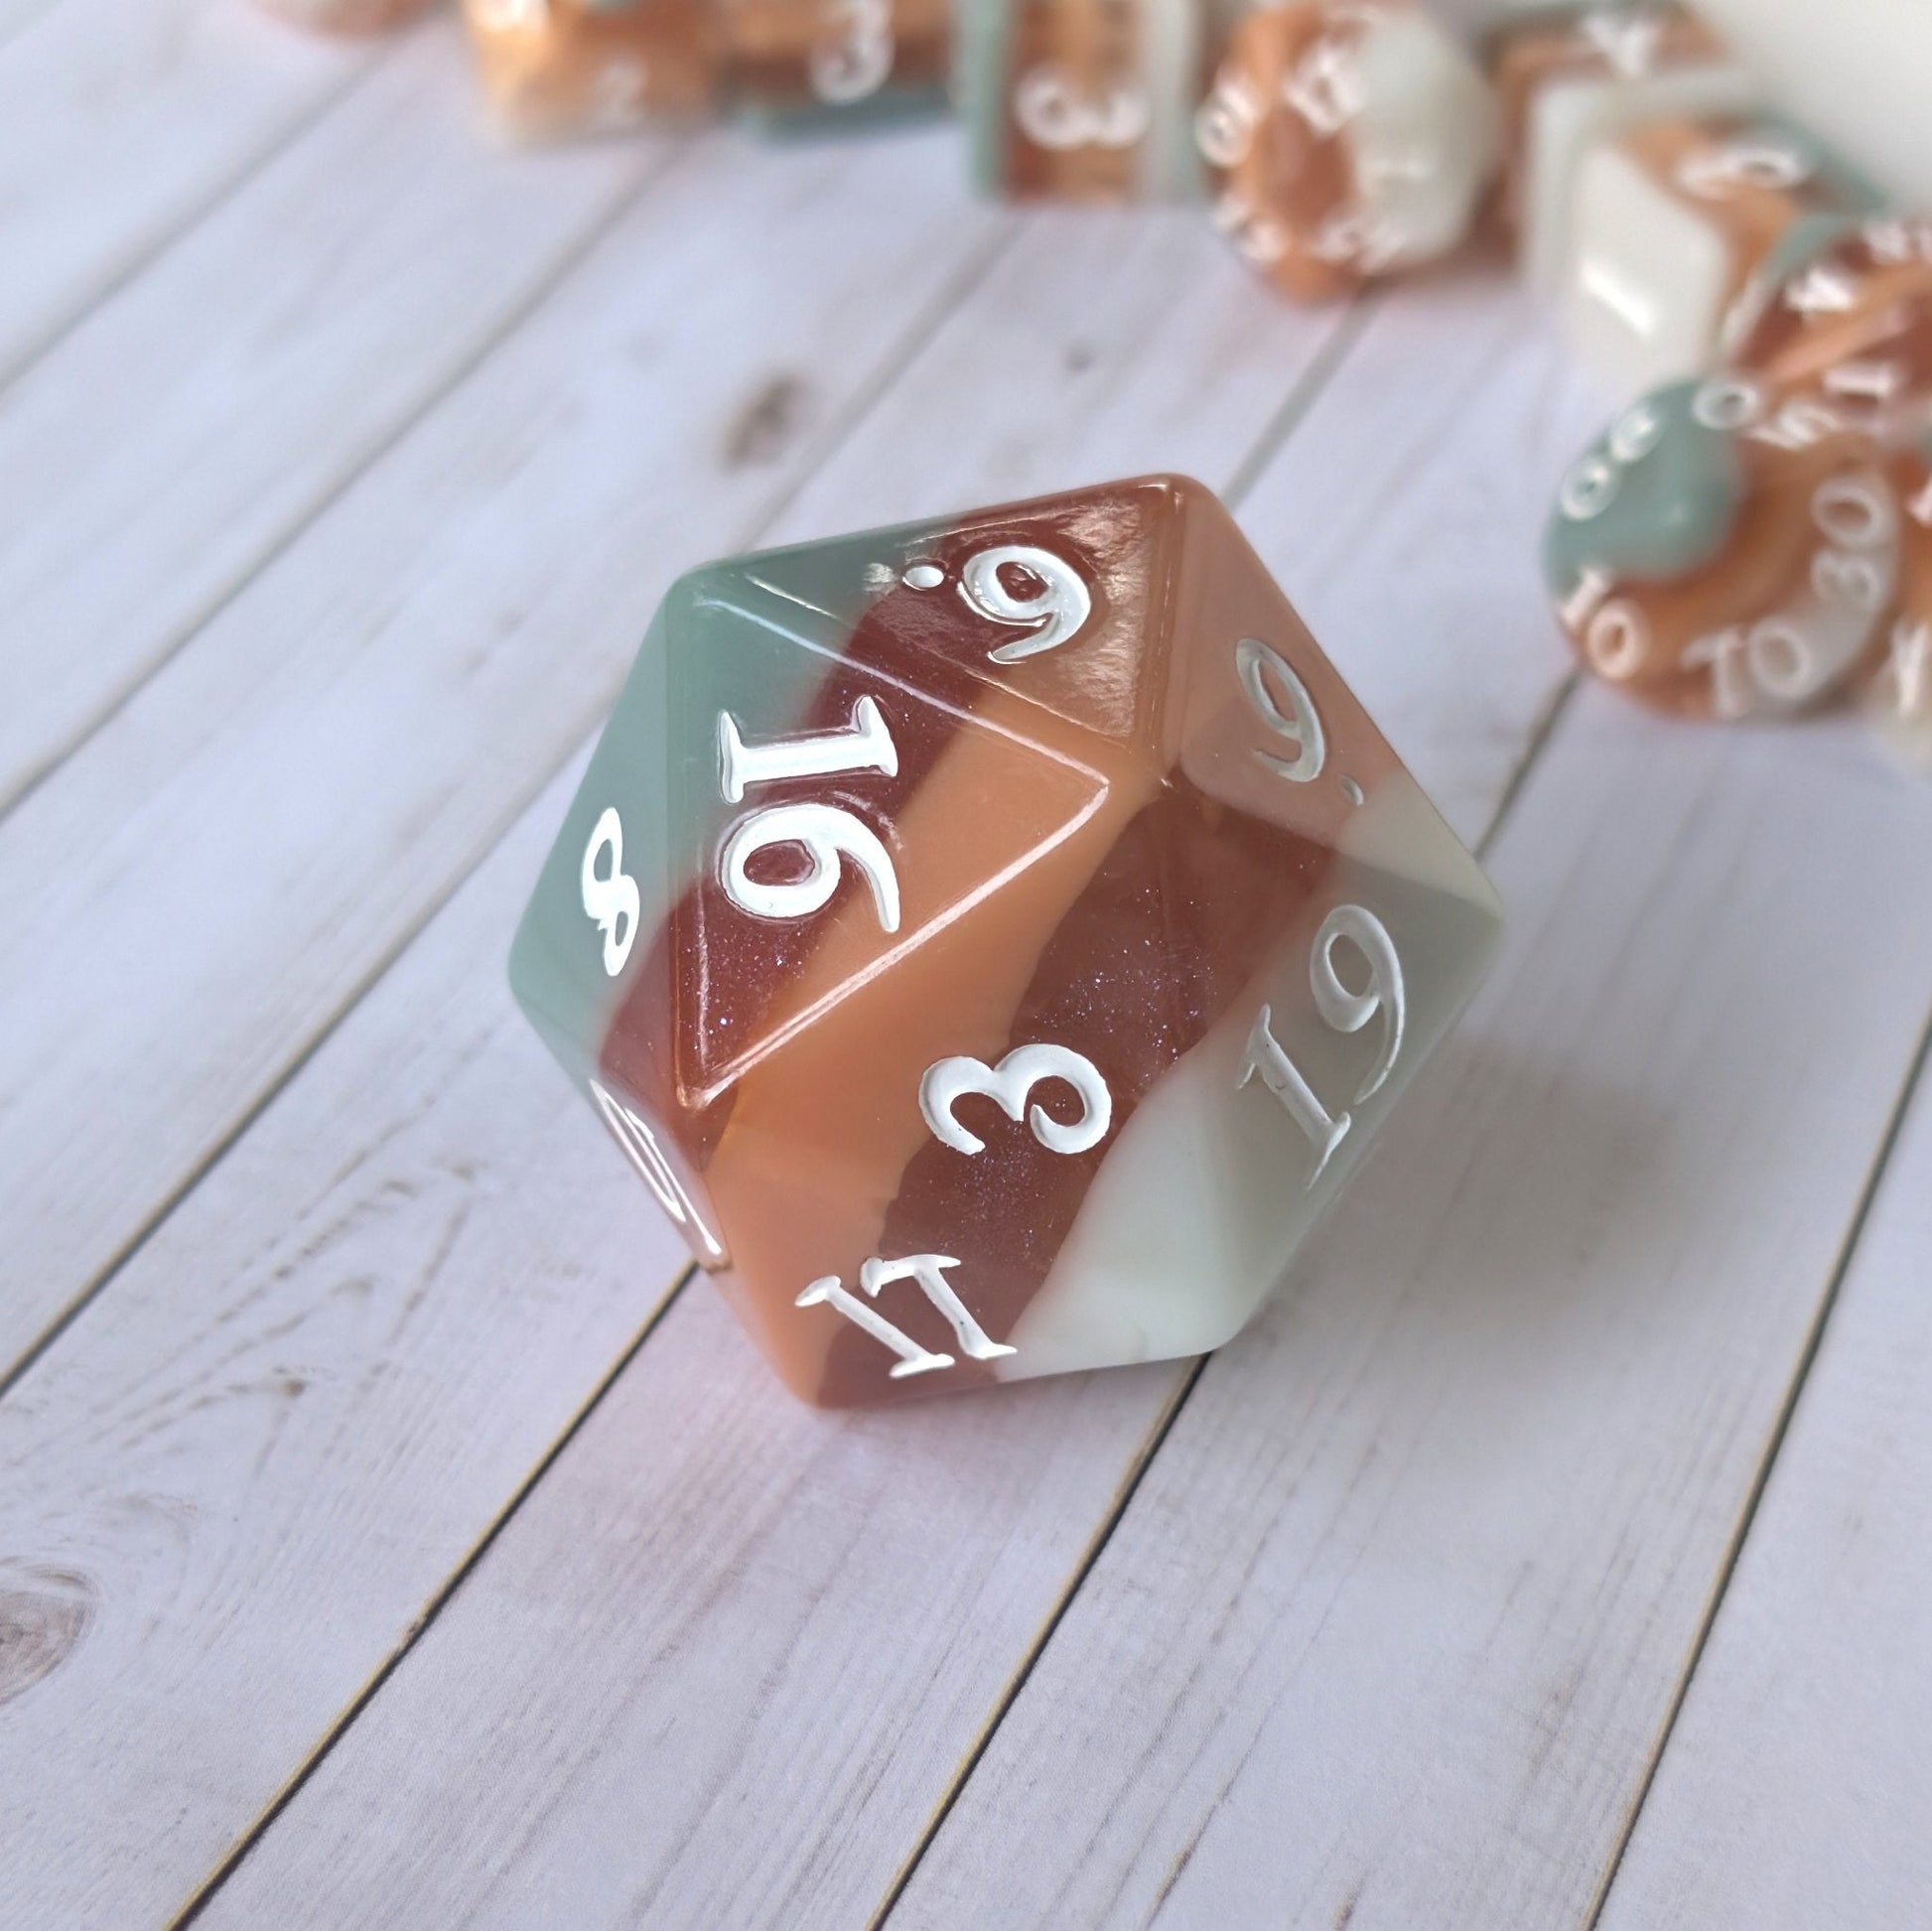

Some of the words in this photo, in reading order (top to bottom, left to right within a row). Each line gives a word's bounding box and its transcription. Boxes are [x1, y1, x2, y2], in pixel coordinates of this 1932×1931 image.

[581, 807, 640, 977] 8
[719, 696, 899, 933] 16
[918, 1044, 1112, 1154] 3
[1238, 904, 1406, 1190] 19
[795, 1255, 1017, 1378] 17
